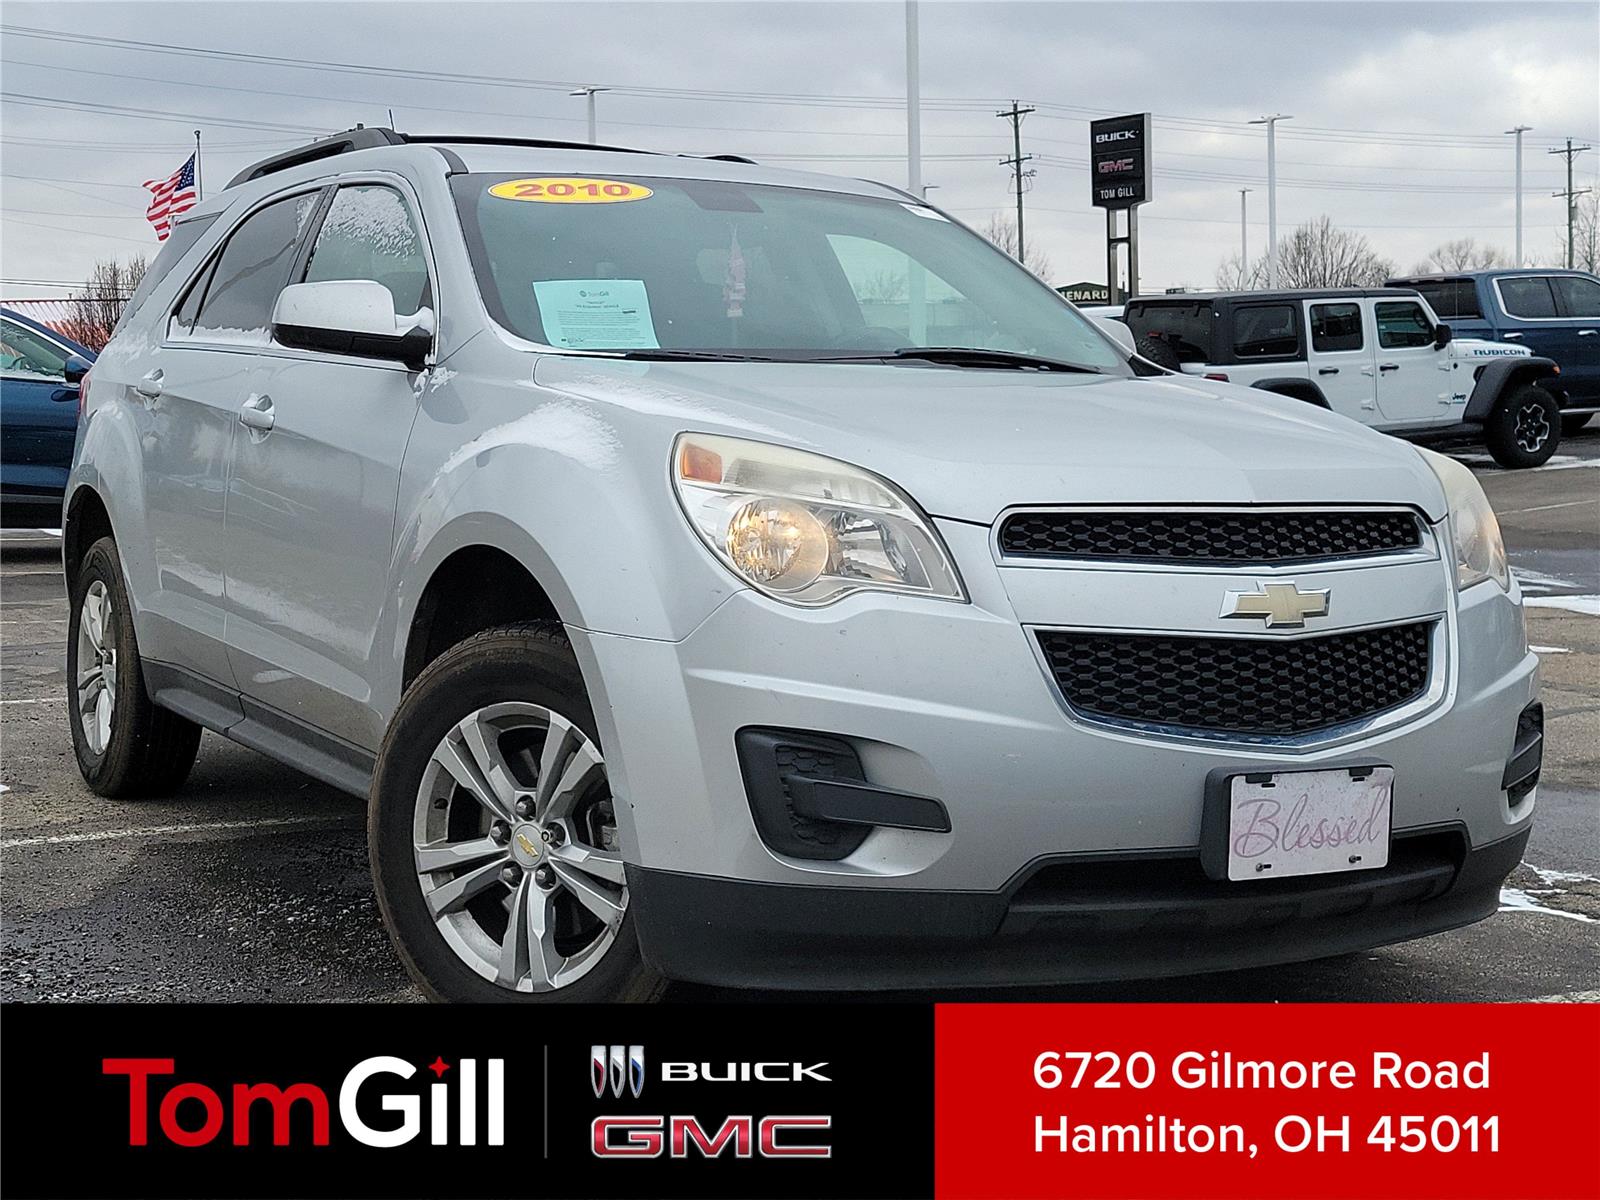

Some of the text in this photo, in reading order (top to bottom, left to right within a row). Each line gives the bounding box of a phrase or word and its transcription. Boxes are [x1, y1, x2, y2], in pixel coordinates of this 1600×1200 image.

[1096, 130, 1136, 143] BUICK
[1098, 158, 1134, 173] GMC
[515, 183, 633, 197] 2010
[1100, 186, 1134, 199] TOM GILL
[1452, 392, 1467, 401] Jeep
[1234, 784, 1389, 858] Blessed
